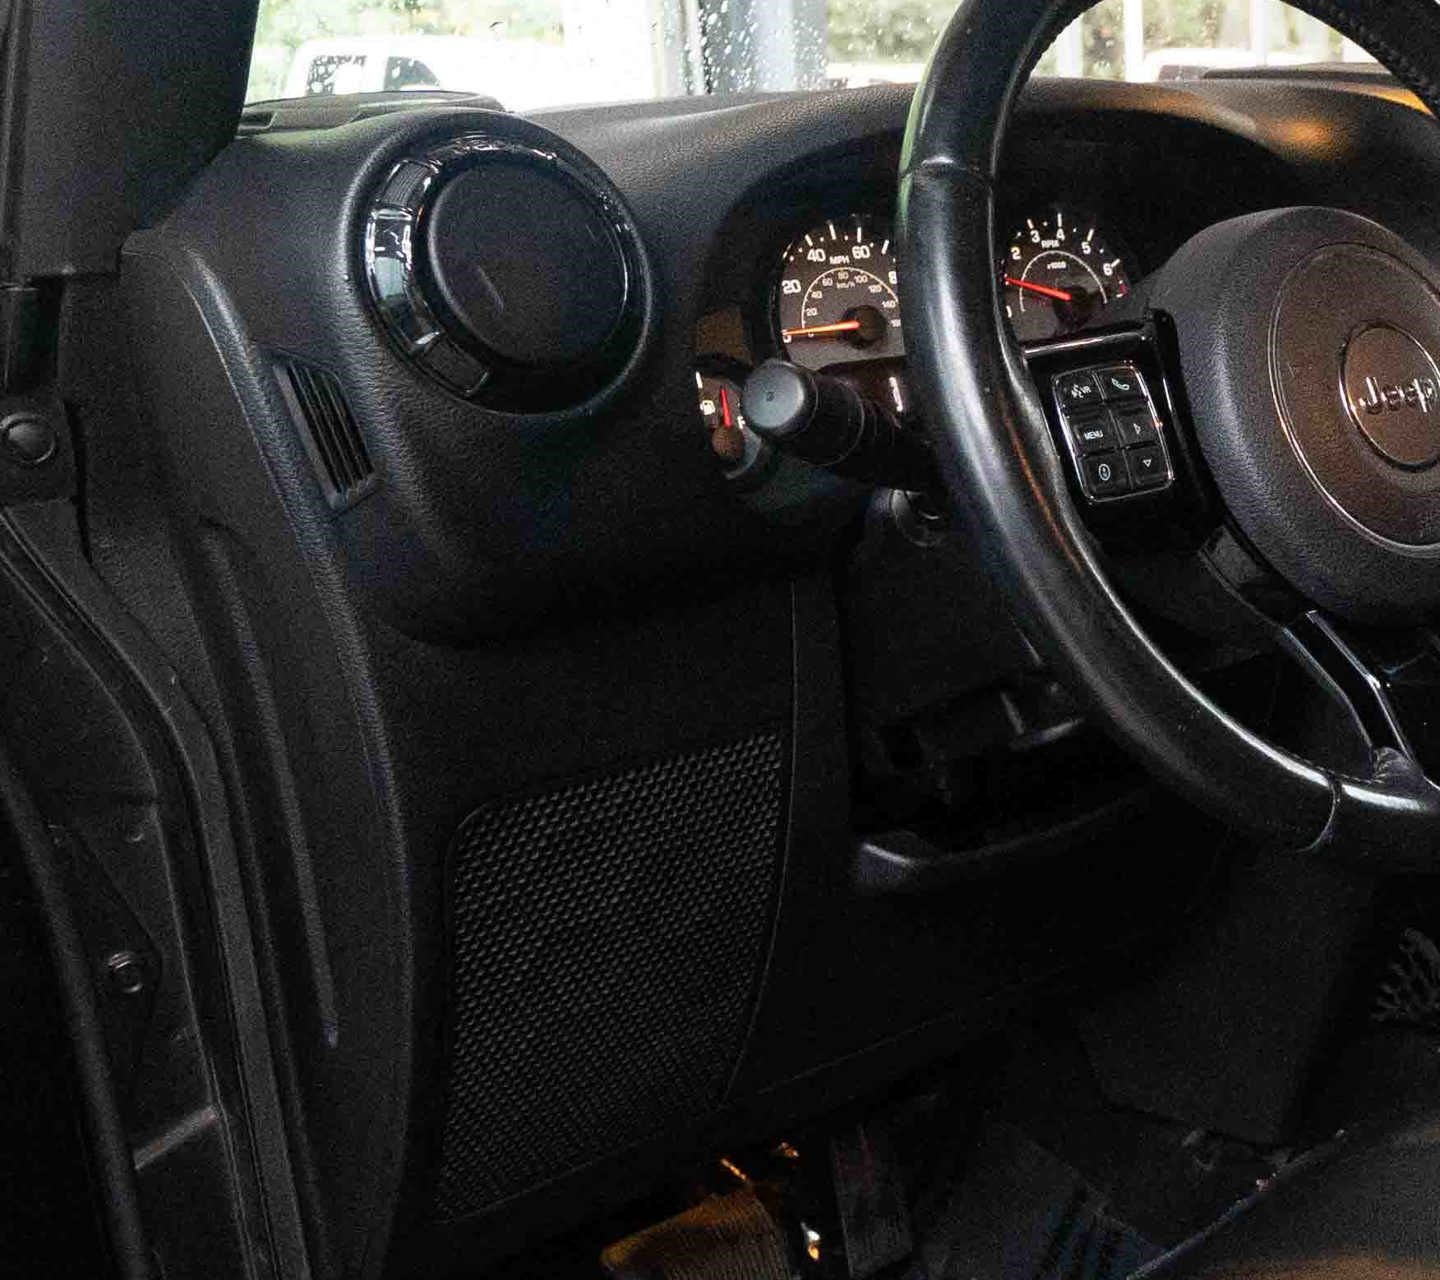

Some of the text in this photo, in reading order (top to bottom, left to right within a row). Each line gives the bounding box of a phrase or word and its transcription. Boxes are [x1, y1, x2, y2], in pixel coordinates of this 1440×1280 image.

[1030, 229, 1040, 243] 3
[1056, 228, 1066, 242] 4
[807, 248, 826, 262] 40
[851, 245, 871, 259] 60
[1010, 246, 1022, 260] 2
[1081, 241, 1091, 255] 5
[1103, 262, 1113, 276] 6
[782, 278, 802, 295] 20
[1358, 376, 1437, 415] Jeep
